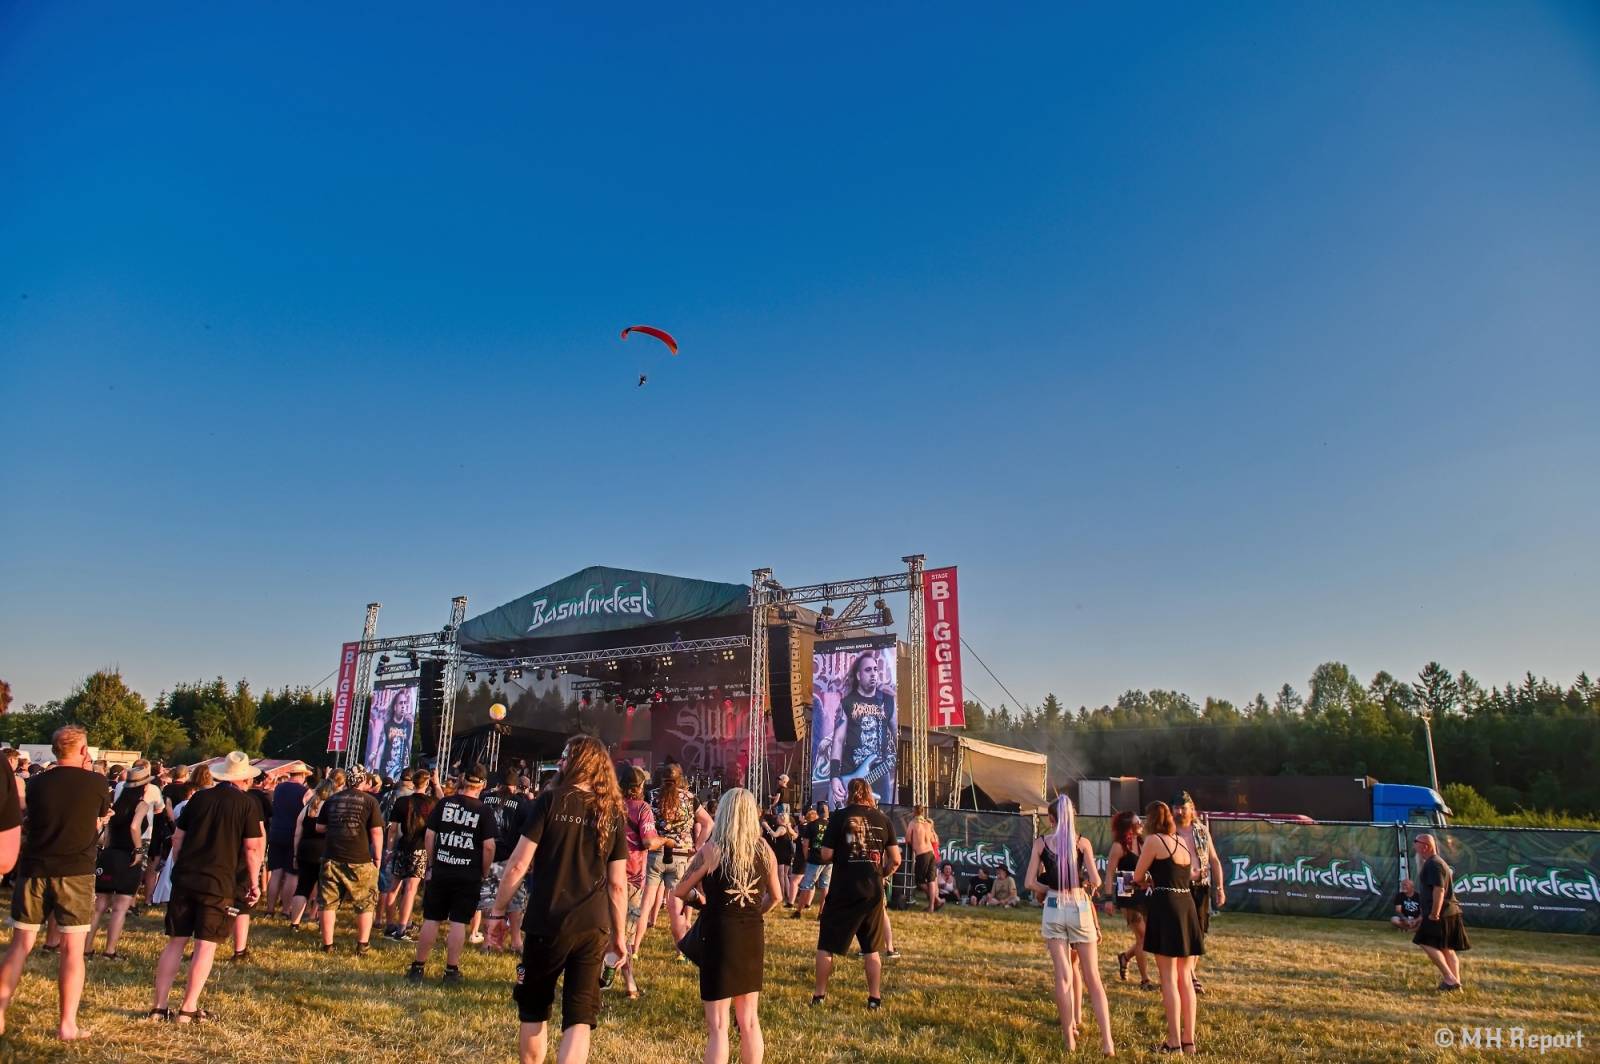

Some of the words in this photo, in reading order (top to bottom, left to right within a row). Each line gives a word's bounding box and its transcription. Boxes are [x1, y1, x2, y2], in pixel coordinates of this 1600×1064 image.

[931, 572, 949, 580] STAGE
[931, 581, 956, 726] BIGGEST
[333, 650, 354, 751] BIGGEST
[441, 806, 479, 828] BŮH
[439, 831, 474, 849] VÍRA
[437, 855, 471, 865] NENÁVIST
[1450, 866, 1600, 903] asinfirefest
